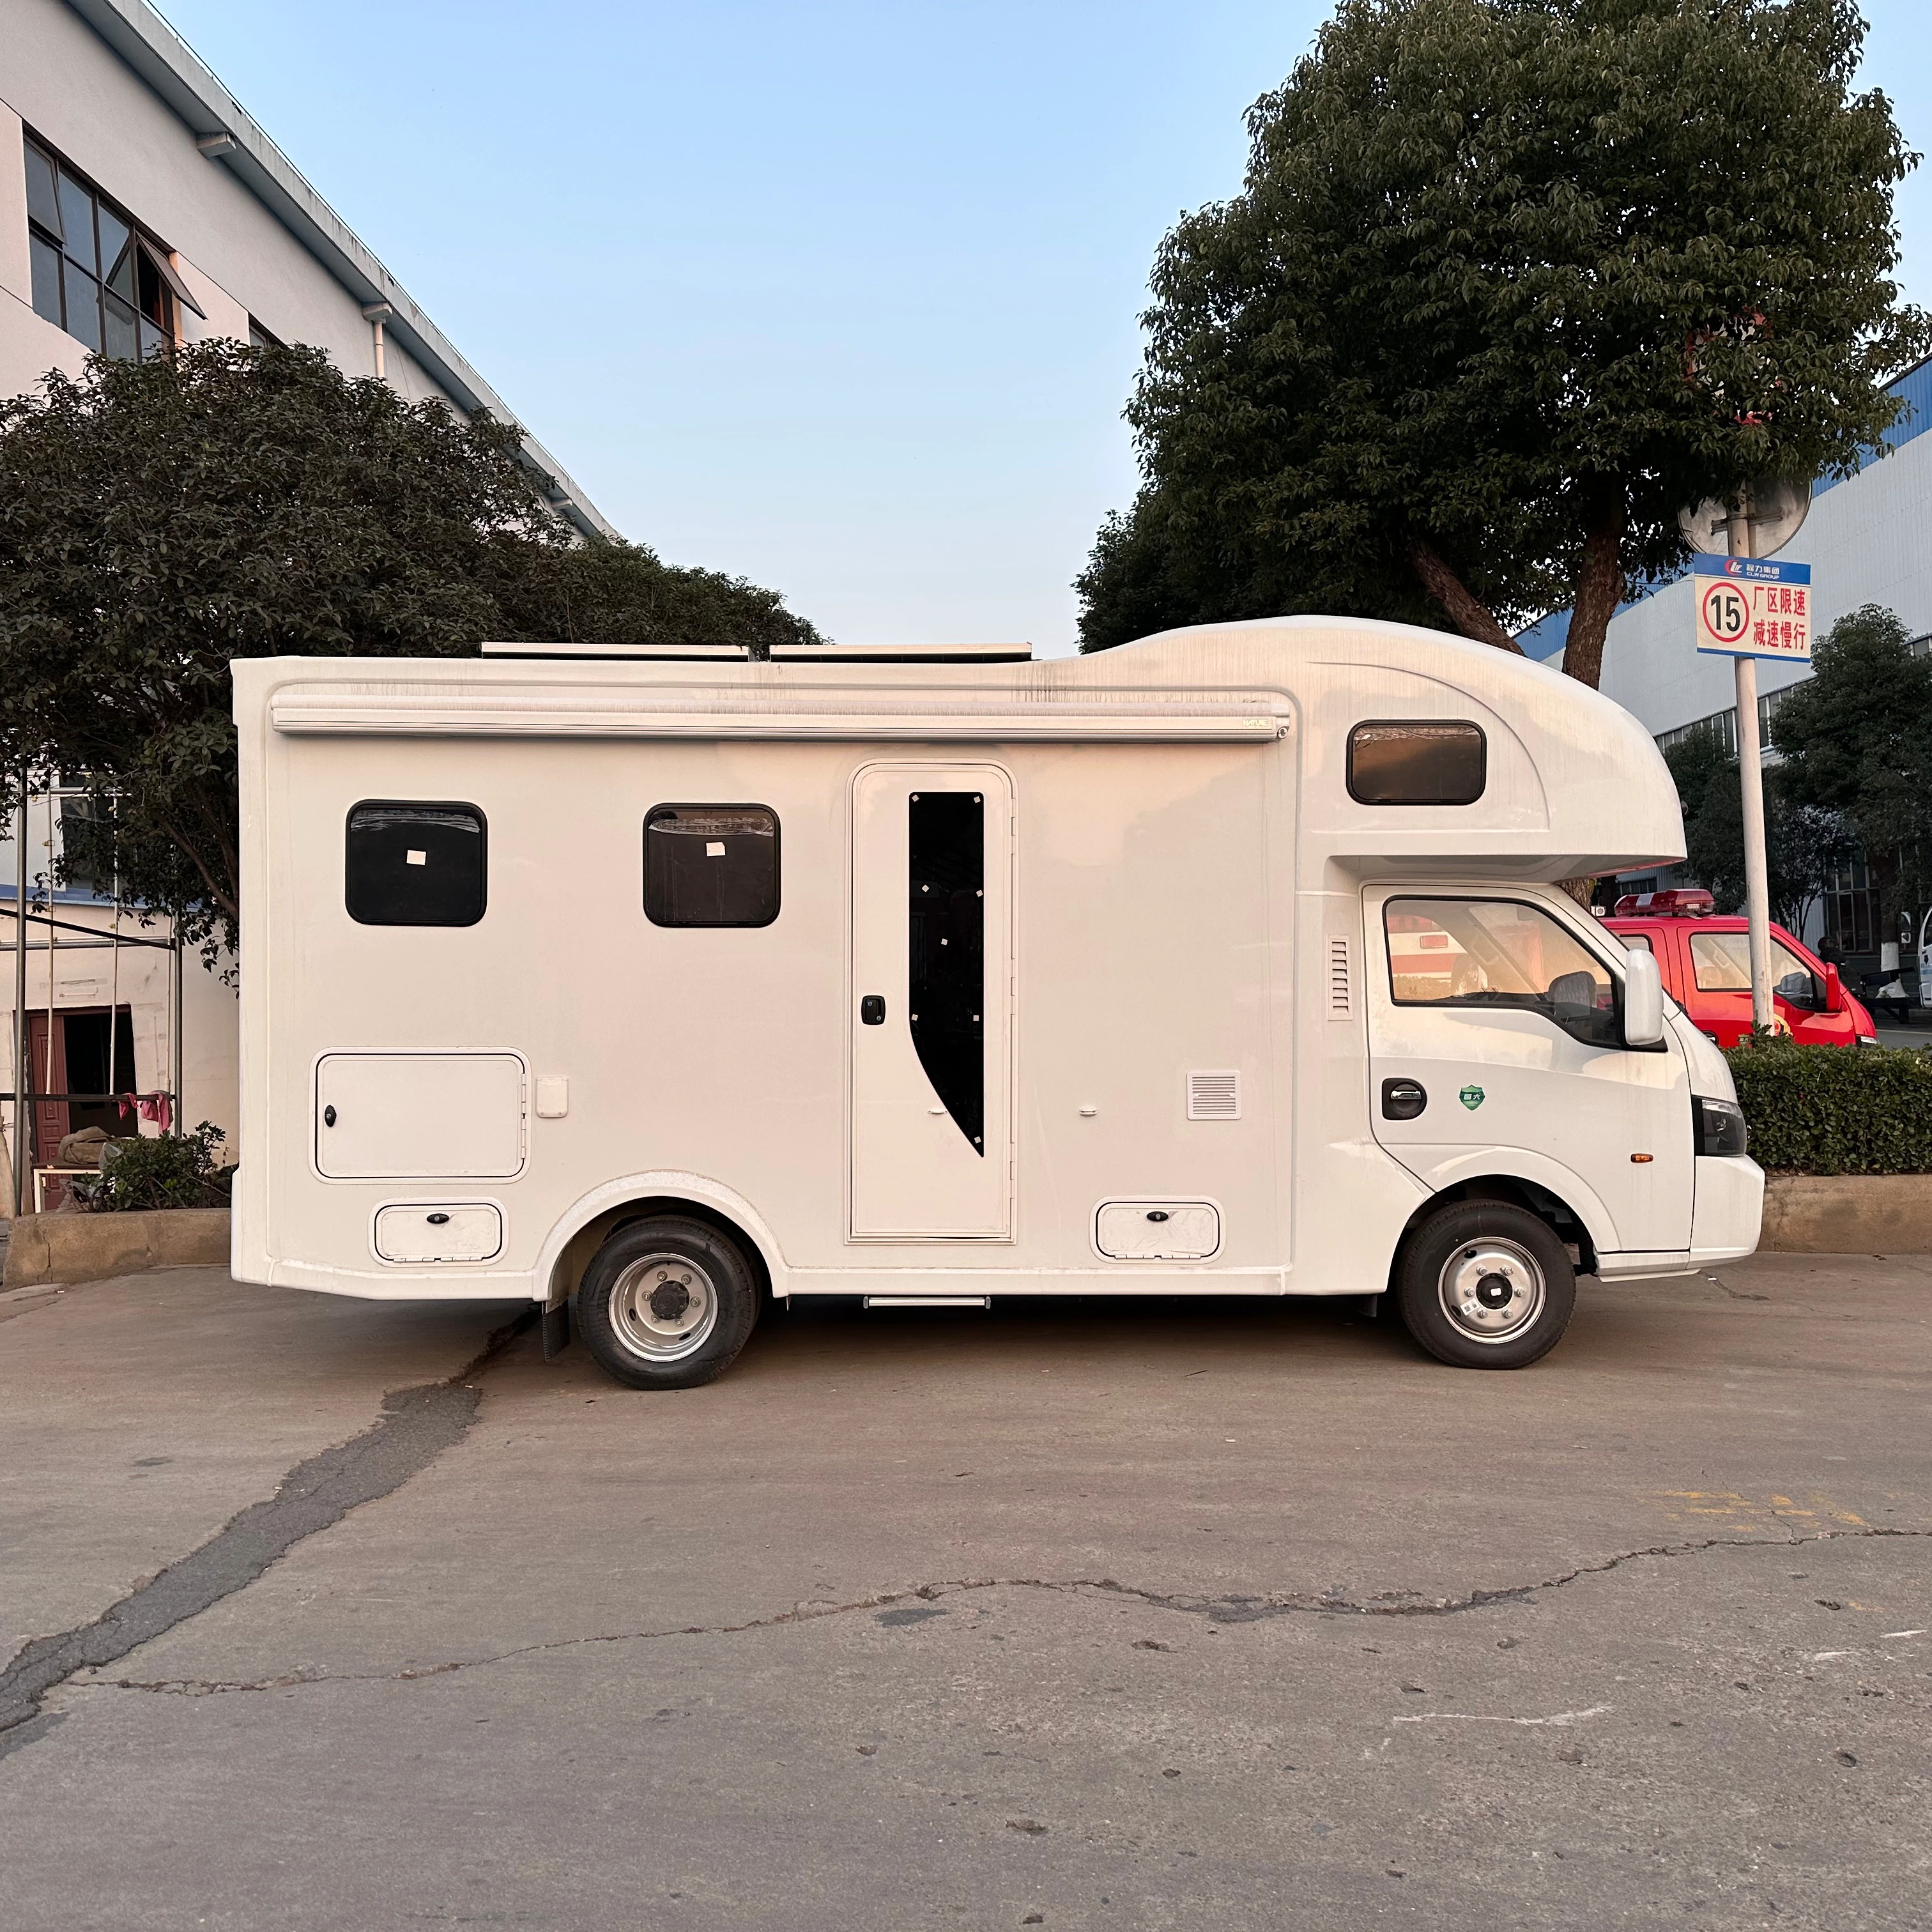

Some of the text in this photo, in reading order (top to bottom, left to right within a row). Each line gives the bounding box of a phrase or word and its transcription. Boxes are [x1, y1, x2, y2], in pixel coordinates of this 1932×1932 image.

[1710, 595, 1740, 632] 15
[1752, 586, 1805, 617] 厂区限速
[1753, 618, 1805, 650] 减速慢行
